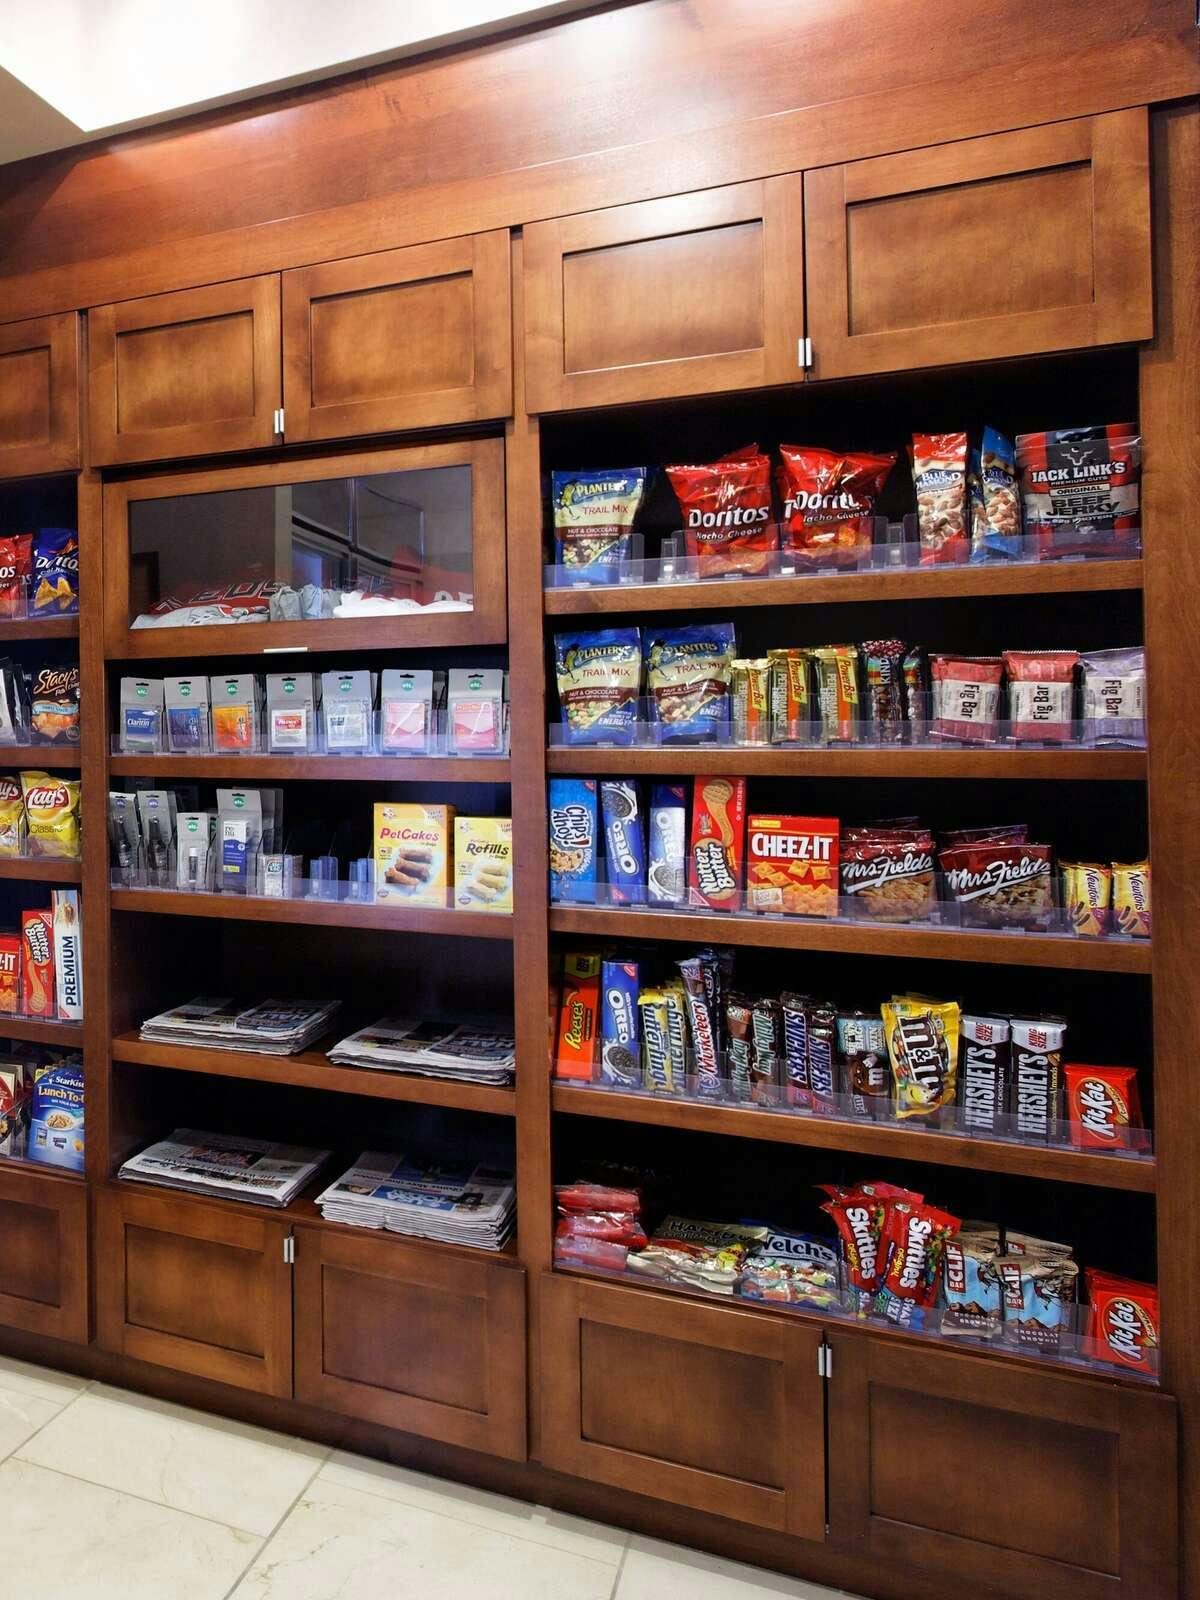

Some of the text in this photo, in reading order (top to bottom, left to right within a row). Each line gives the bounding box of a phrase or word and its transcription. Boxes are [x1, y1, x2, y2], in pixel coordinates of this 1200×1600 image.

[923, 472, 946, 482] BLUE
[1032, 461, 1126, 483] JACK LINK'S
[582, 501, 628, 514] TRAIL MIX
[1052, 495, 1111, 508] BEEF
[1056, 486, 1102, 495] ORIGINAL
[689, 505, 769, 527] Doritos
[803, 515, 832, 523] acho
[1046, 502, 1120, 516] JERKY
[696, 528, 762, 539] Nacho Cheese
[34, 668, 79, 694] Stacy's
[611, 668, 630, 677] MIX
[789, 659, 804, 698] PowerBar
[839, 660, 855, 698] PowerBar
[880, 658, 891, 684] KIND
[960, 684, 980, 718] Fig Bar
[1033, 686, 1053, 721] Fig Bar
[1101, 680, 1122, 716] Fig Bar
[28, 787, 65, 809] Lay's
[31, 824, 63, 833] Classic
[656, 811, 677, 862] OREO
[466, 842, 509, 855] Refills
[612, 821, 639, 875] OREO
[752, 833, 833, 859] CHEEZ-IT
[696, 848, 719, 894] Nutter
[709, 843, 735, 890] Butter
[873, 853, 932, 884] Fields
[988, 858, 1050, 892] Fields
[1086, 870, 1097, 907] Newtons
[1128, 871, 1143, 911] Newtons
[25, 927, 42, 963] Butter
[36, 922, 50, 960] Nutter
[63, 936, 77, 1006] PREMIUM
[608, 990, 630, 1043] OREO
[976, 1022, 984, 1041] KING
[984, 1025, 993, 1042] SIZE
[693, 1001, 717, 1076] Musketeers
[785, 1009, 807, 1083] SNICKERS
[1029, 1028, 1037, 1047] KING
[1038, 1031, 1047, 1049] SIZE
[809, 1037, 833, 1098] SNICKERS
[39, 1086, 67, 1099] Lunch
[965, 1047, 997, 1129] HERSHEY'S
[1018, 1054, 1048, 1134] HERSHEY'S
[846, 1207, 877, 1279] Skittles
[900, 1217, 932, 1289] Skittles
[946, 1245, 964, 1281] CLIF
[1014, 1329, 1059, 1338] CHOCOLAT
